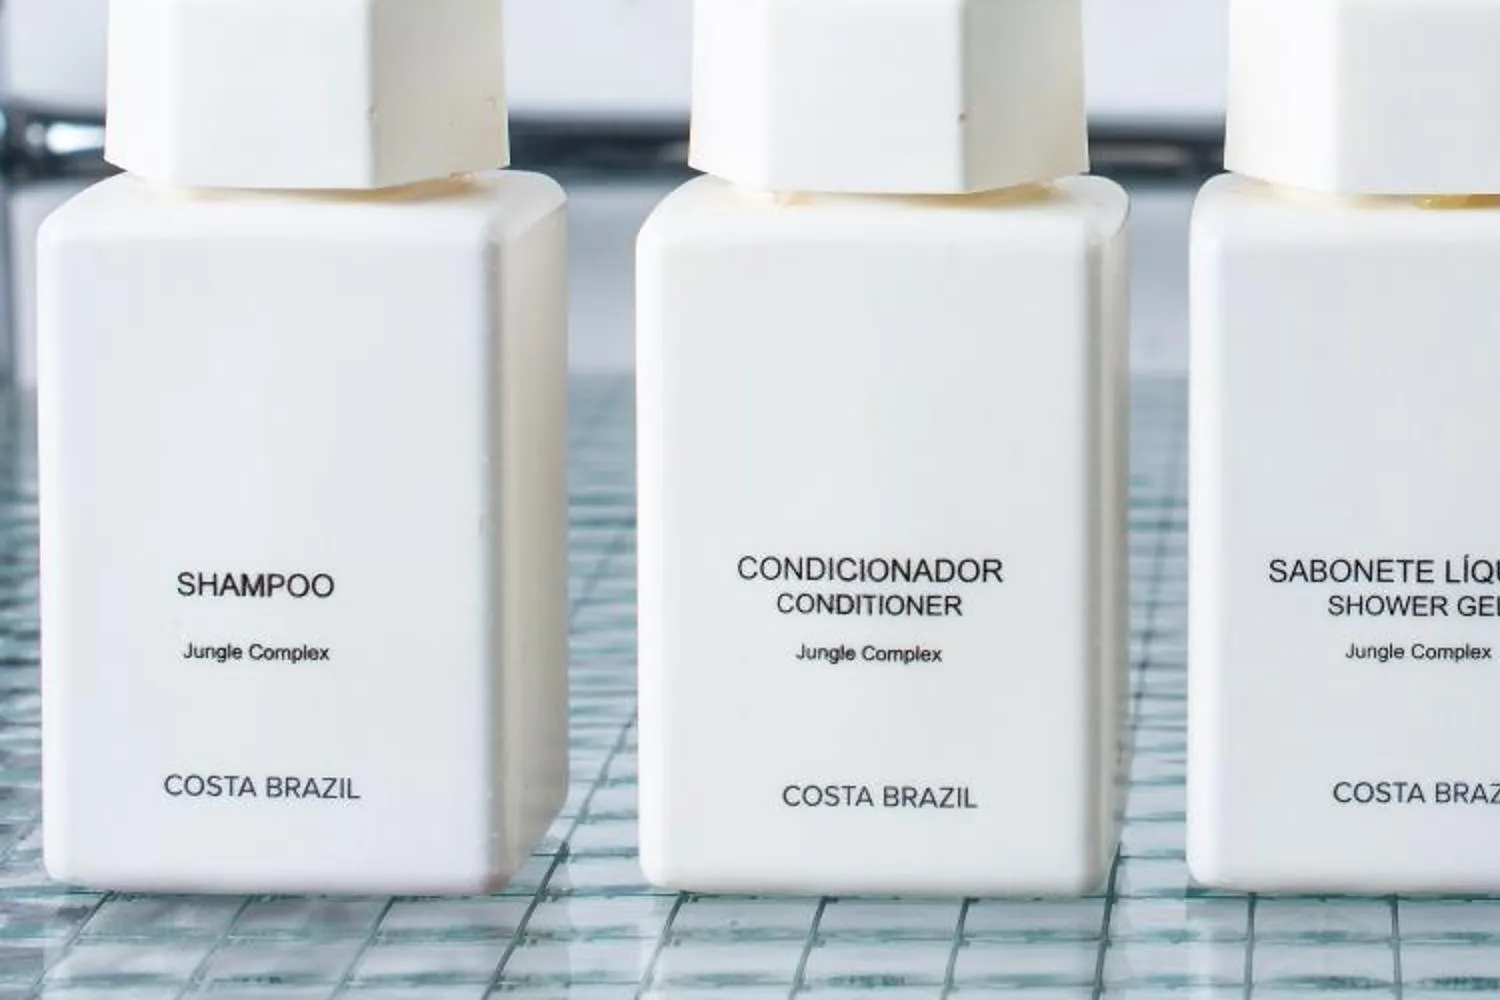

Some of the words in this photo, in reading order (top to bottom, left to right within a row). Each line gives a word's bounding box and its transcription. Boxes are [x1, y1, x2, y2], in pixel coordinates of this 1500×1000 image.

[738, 555, 1003, 583] CONDICIONADOR
[1268, 558, 1434, 584] SABONETE
[177, 571, 335, 598] SHAMPOO
[777, 592, 963, 617] CONDITIONER
[1328, 595, 1448, 617] SHOWER
[183, 641, 243, 664] Jungle
[248, 642, 330, 664] Complex
[795, 642, 856, 665] Jungle
[861, 644, 943, 665] Complex
[1345, 642, 1405, 664] Jungle
[1411, 643, 1492, 664] Complex
[163, 773, 257, 798] COSTA
[266, 776, 361, 800] BRAZIL
[782, 784, 874, 808] COSTA
[883, 785, 978, 809] BRAZIL
[1333, 780, 1426, 804] COSTA
